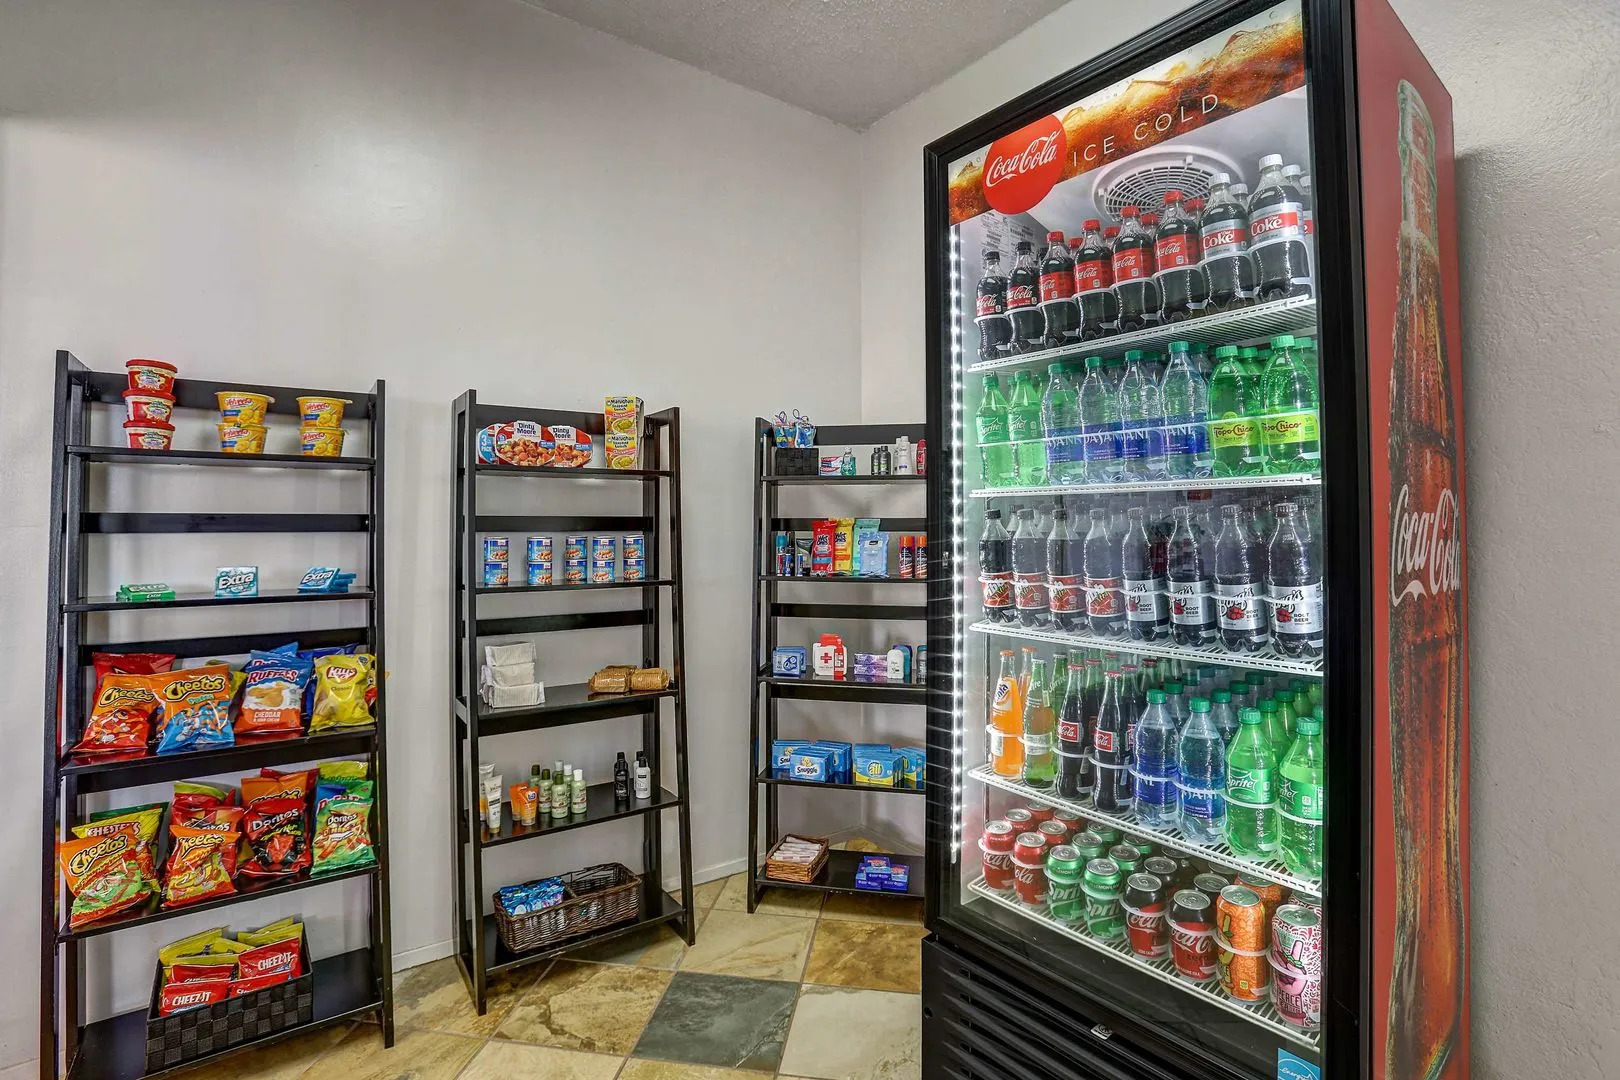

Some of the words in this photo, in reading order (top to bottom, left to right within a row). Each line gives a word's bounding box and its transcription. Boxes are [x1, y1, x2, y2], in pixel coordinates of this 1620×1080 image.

[1073, 136, 1115, 168] ICE
[1133, 93, 1219, 142] COLD
[1251, 216, 1282, 236] Coke
[1203, 231, 1234, 249] Coke
[518, 423, 535, 431] Dinty
[218, 573, 254, 587] Extra
[303, 571, 333, 582] Extra
[165, 676, 225, 701] Cheetos
[99, 688, 157, 707] Cheetos
[797, 766, 818, 775] Snuggle
[869, 762, 882, 775] all
[1227, 776, 1254, 790] Sprite
[252, 808, 300, 831] Doritos
[69, 834, 127, 876] Cheetos
[172, 992, 212, 1006] CHEEZ-IT
